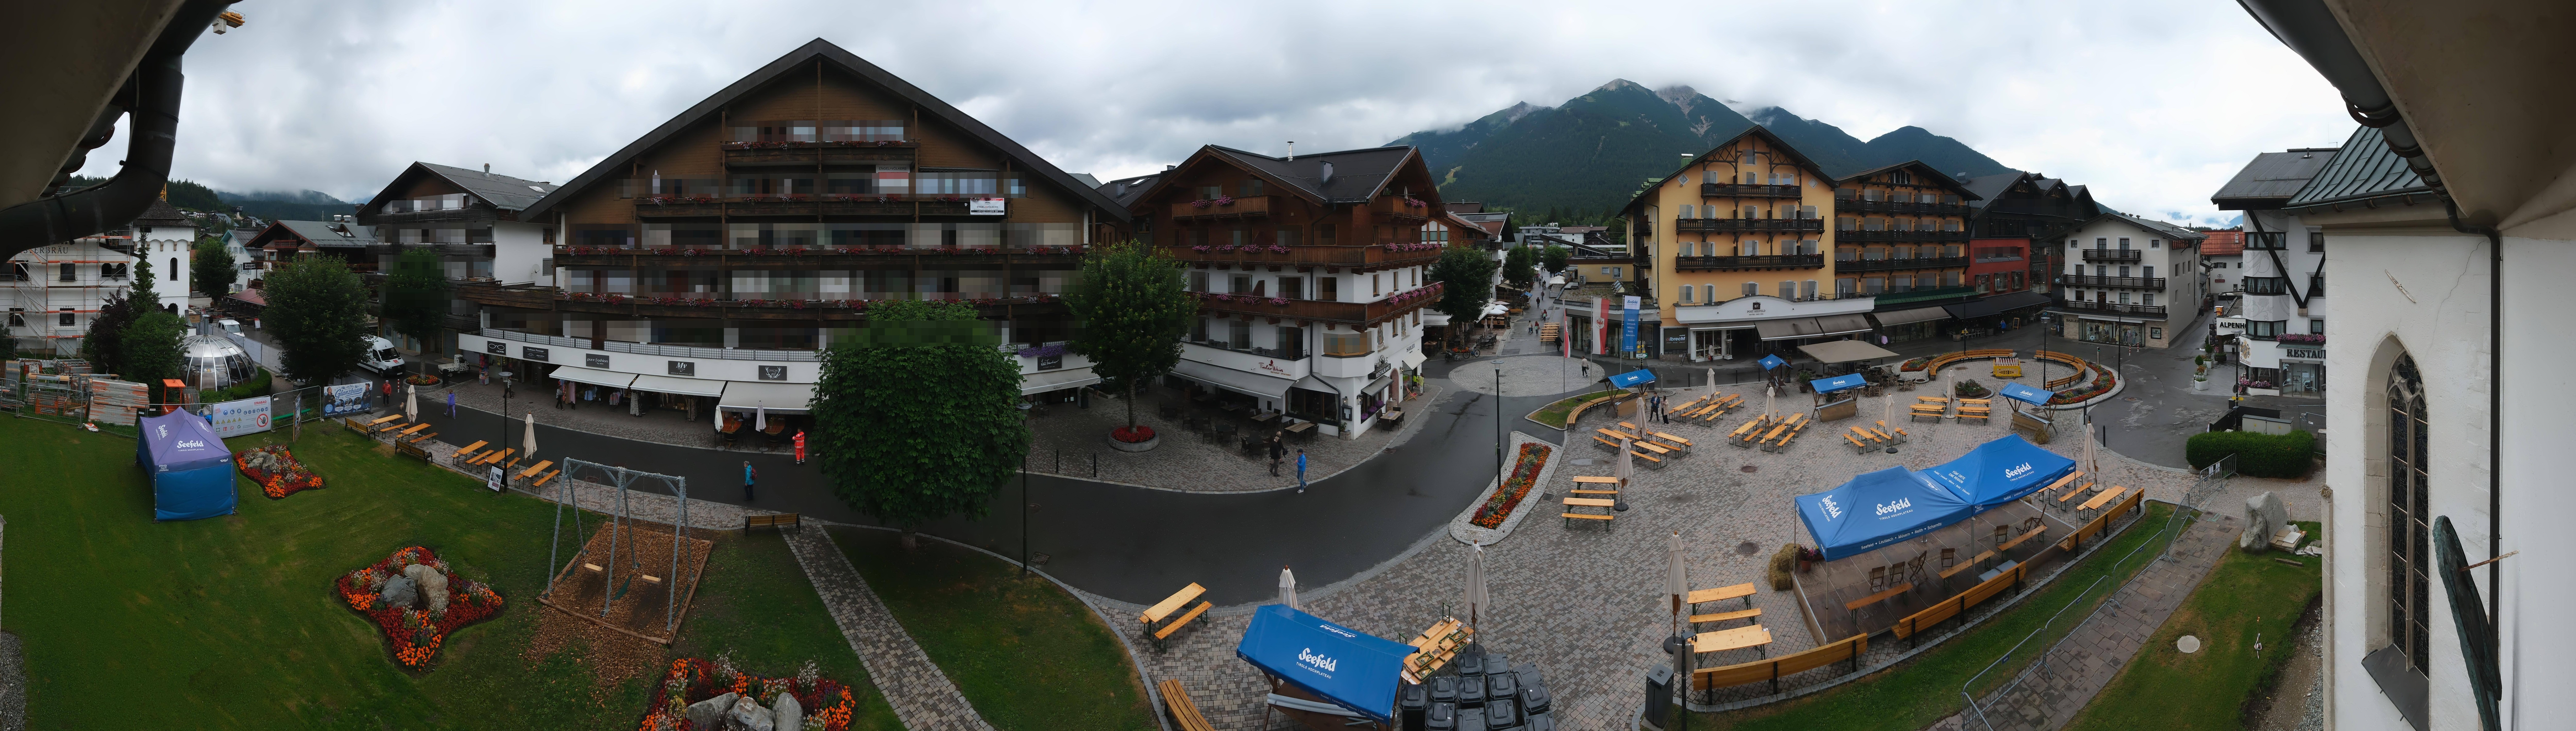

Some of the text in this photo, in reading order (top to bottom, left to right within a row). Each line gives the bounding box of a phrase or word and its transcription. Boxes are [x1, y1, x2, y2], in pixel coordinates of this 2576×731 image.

[1376, 365, 1390, 378] RESTAURANT
[335, 387, 363, 400] Glanzbuam
[158, 424, 168, 438] Seefeld
[2005, 462, 2032, 478] Seefeld
[1822, 495, 1842, 518] Seefeld
[1876, 497, 1911, 515] Seefeld
[1891, 509, 1913, 517] HOCHPLATEAU
[1821, 507, 1831, 522] HOCHPLATEAU
[1319, 625, 1355, 638] Seefeld
[1299, 647, 1336, 672] Seefeld
[1308, 667, 1332, 679] HOCHPLATEAU
